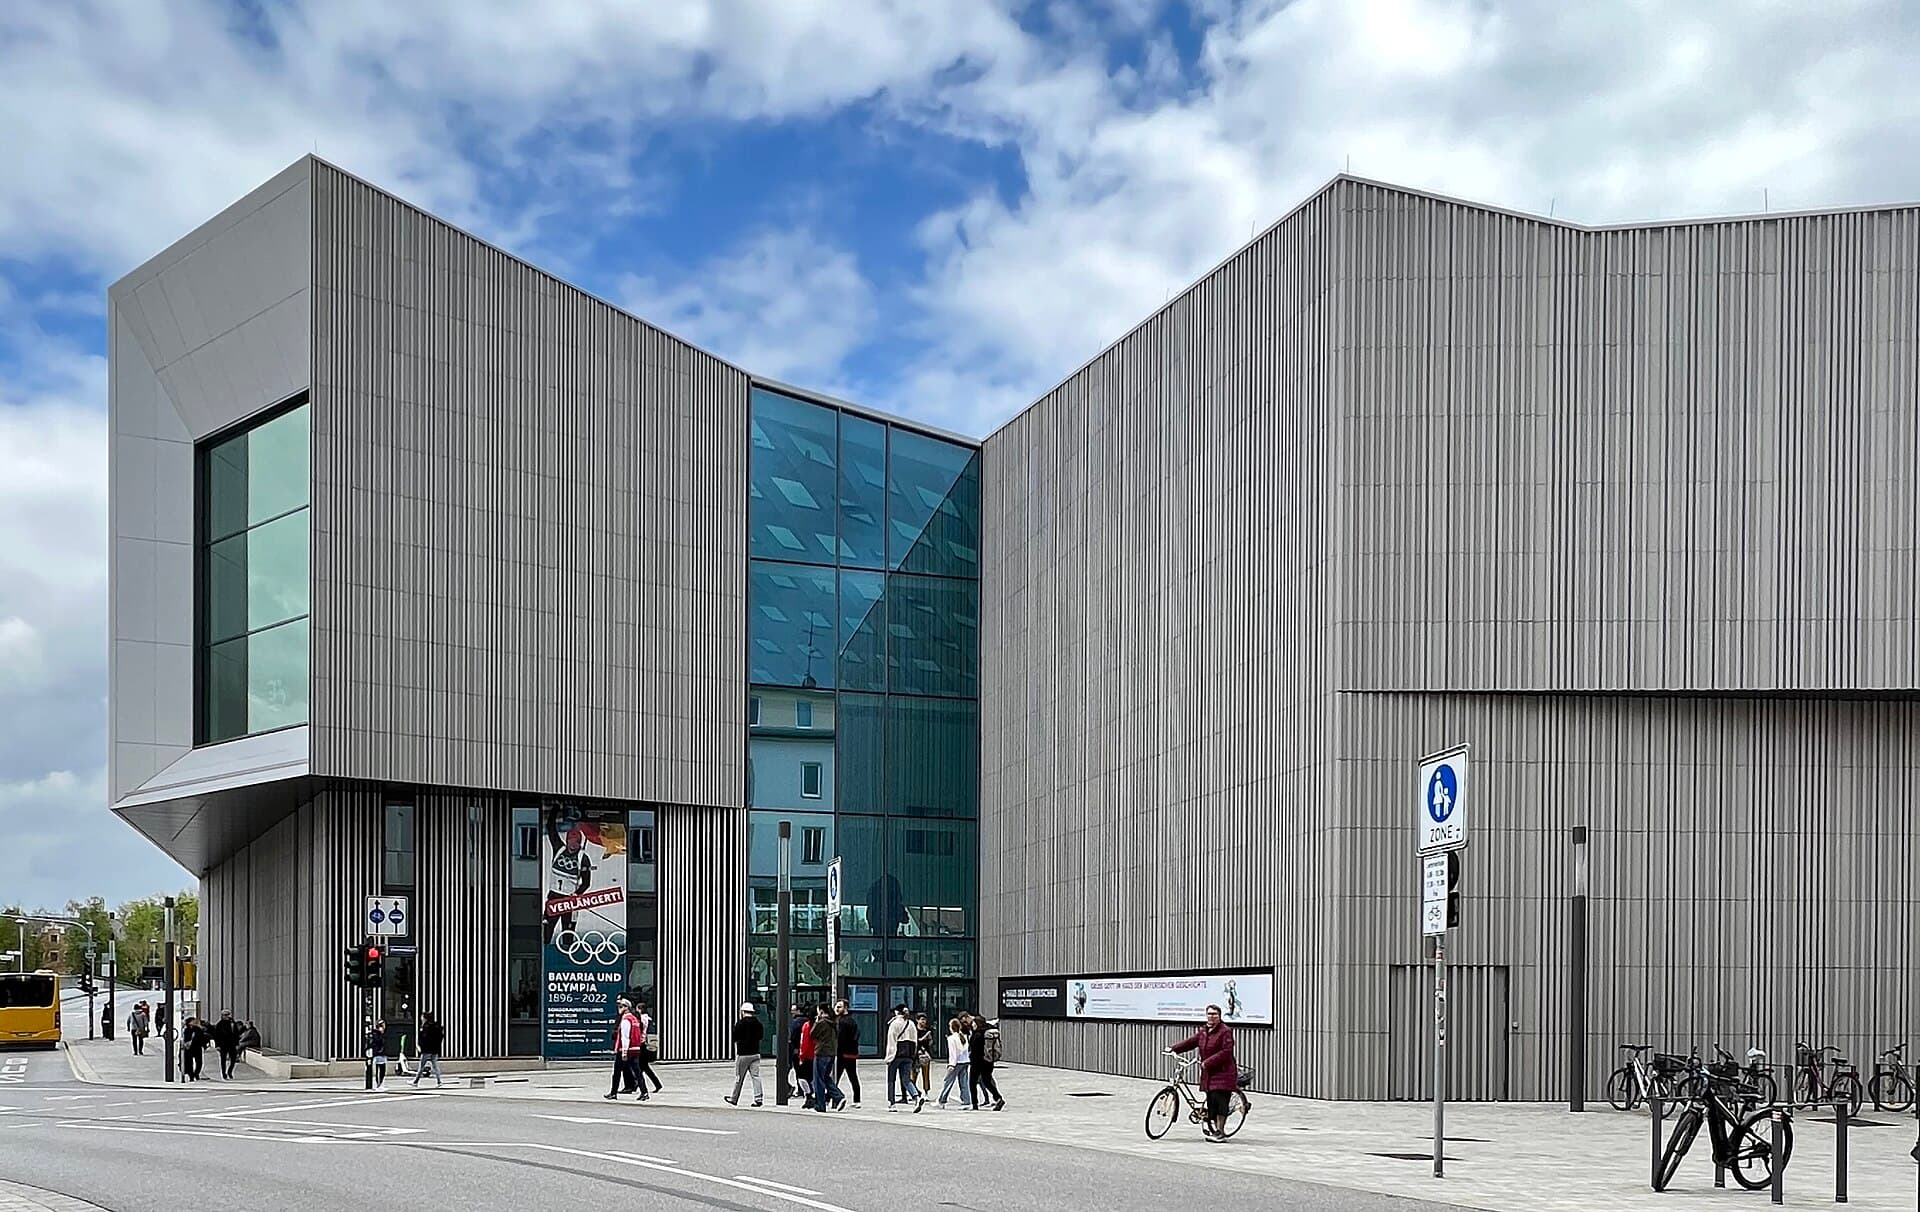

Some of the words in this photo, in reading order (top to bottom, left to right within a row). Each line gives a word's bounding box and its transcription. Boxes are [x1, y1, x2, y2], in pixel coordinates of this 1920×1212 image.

[1430, 824, 1453, 843] ZONE
[549, 891, 622, 913] VERLÄNGERT!
[548, 972, 595, 982] BAVARIA
[597, 972, 622, 983] UND
[548, 982, 597, 993] OLYMPIA
